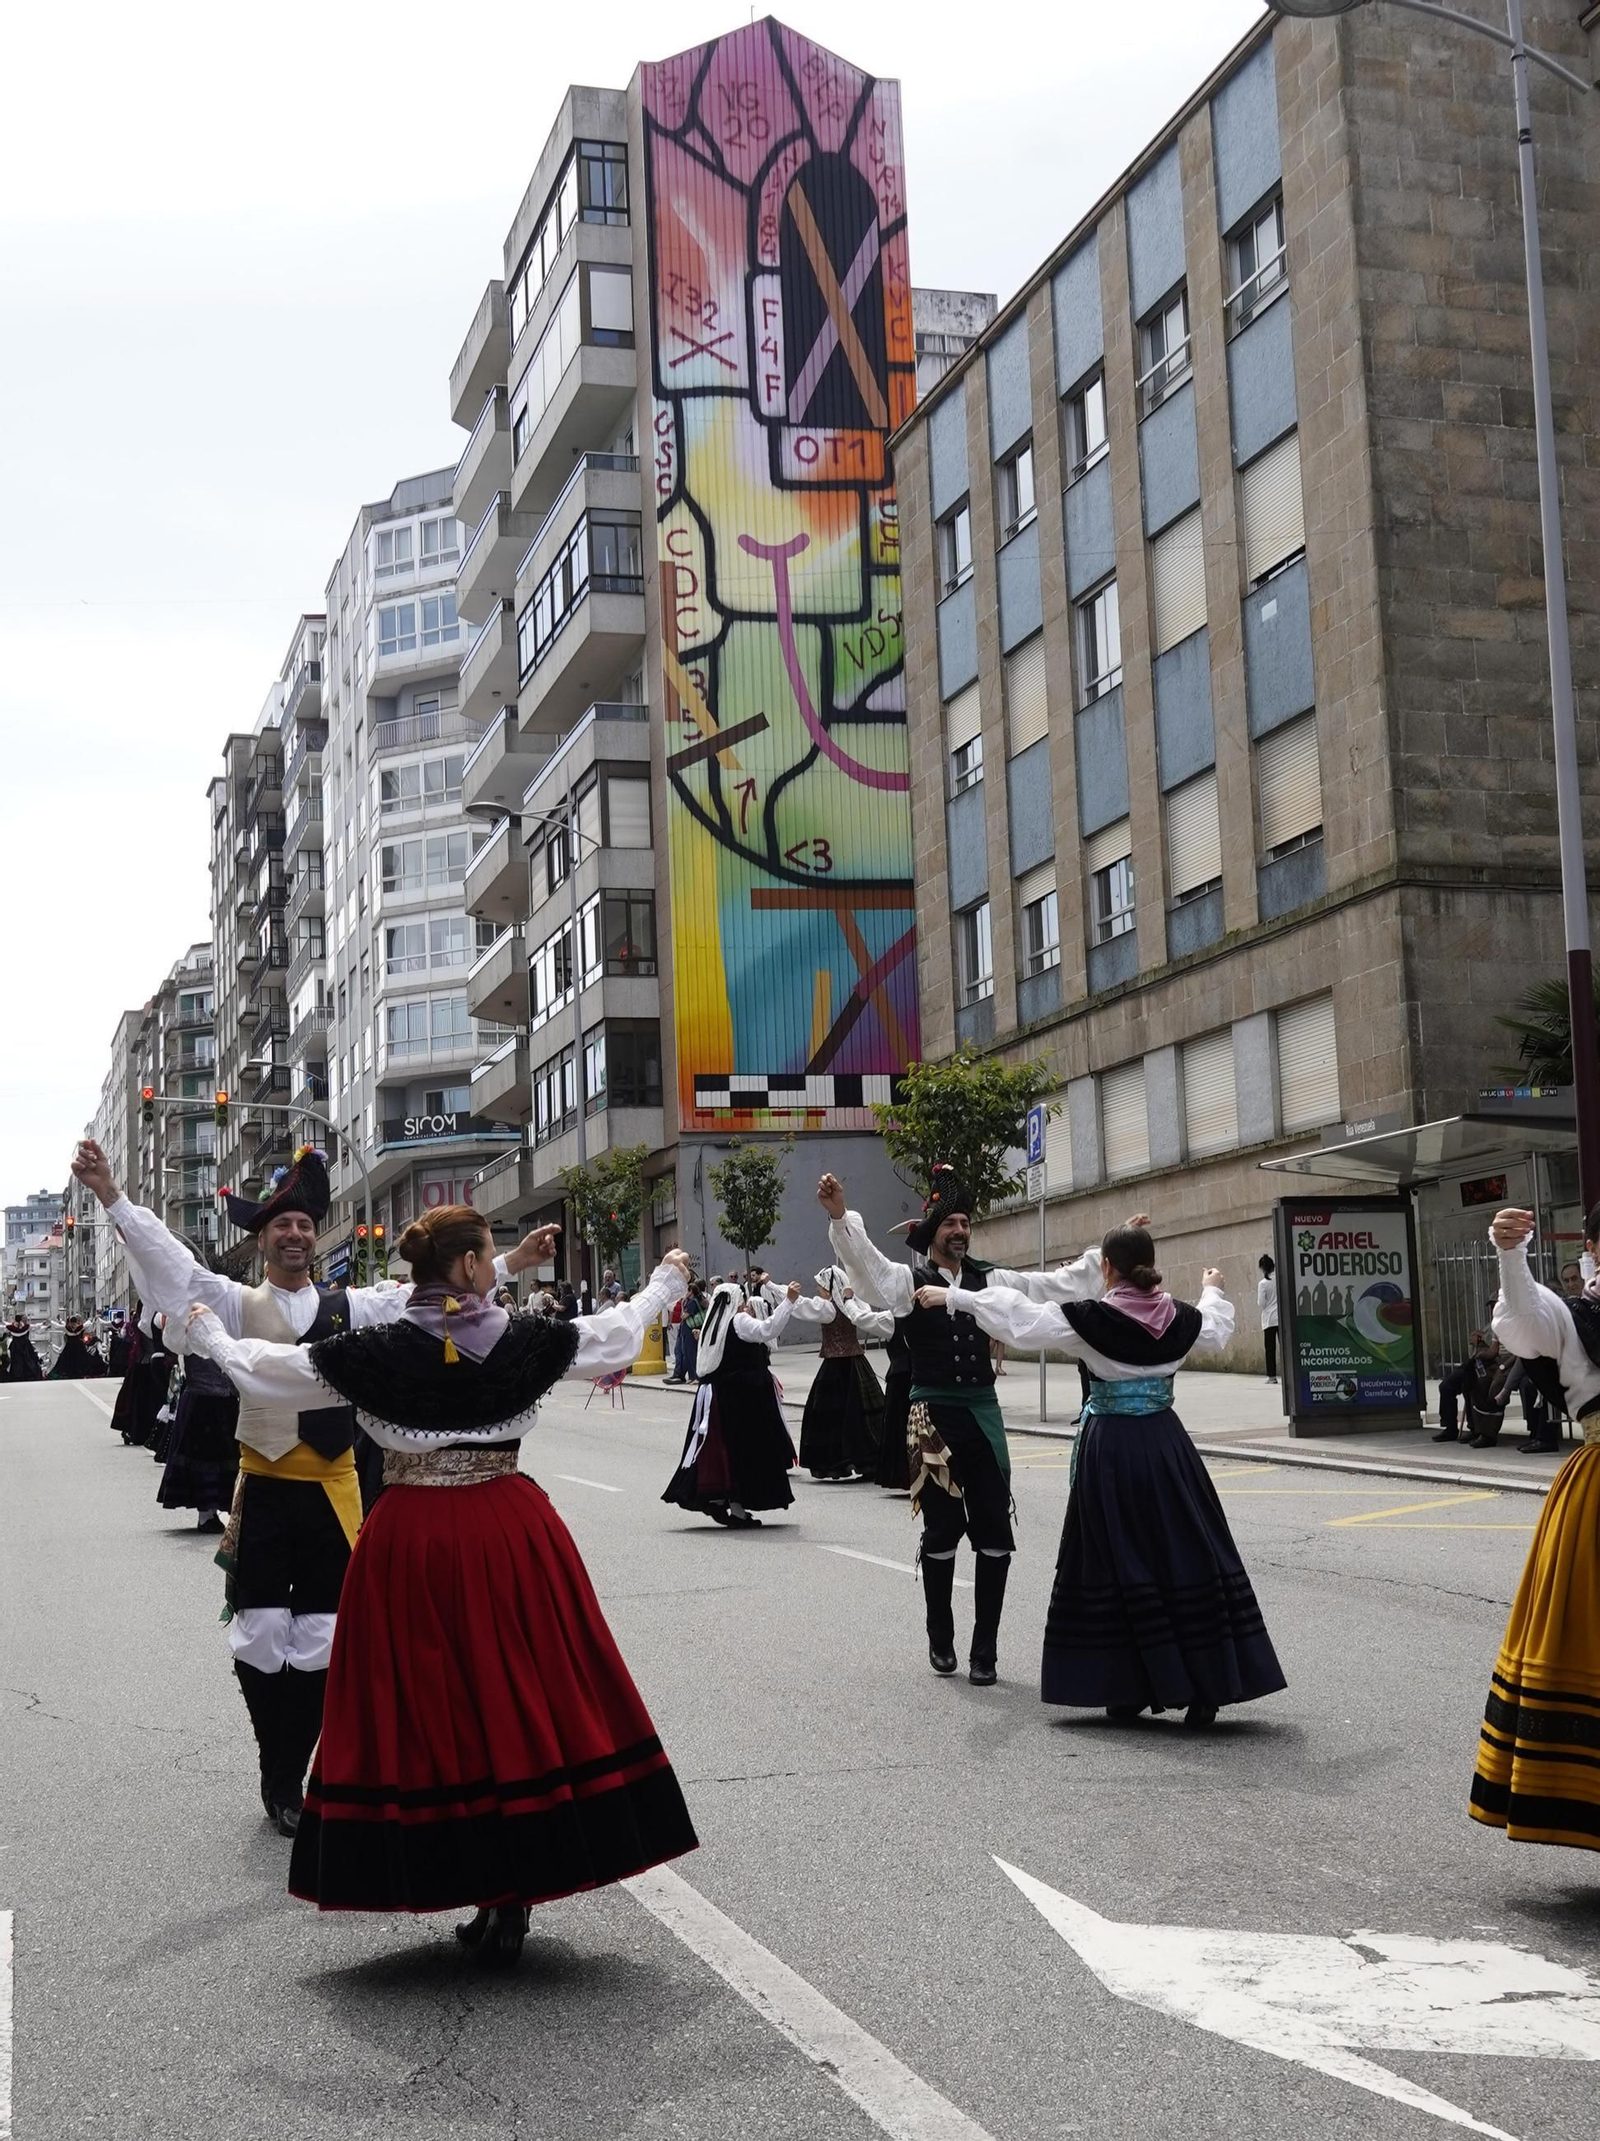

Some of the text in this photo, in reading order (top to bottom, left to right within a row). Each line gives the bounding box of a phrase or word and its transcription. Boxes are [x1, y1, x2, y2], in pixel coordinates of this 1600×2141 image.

[761, 299, 781, 403] F4F
[793, 434, 866, 465] OT1
[666, 528, 701, 640] CDC
[784, 838, 833, 874] <3
[1294, 1215, 1323, 1223] NUEVO
[1317, 1231, 1380, 1250] ARIEL
[1300, 1251, 1403, 1277] PODEROSO
[1300, 1347, 1351, 1356] 4 ADITIVOS
[1301, 1356, 1373, 1366] INCORPORADOS
[1360, 1379, 1412, 1388] ENCUÉNTRALO EN
